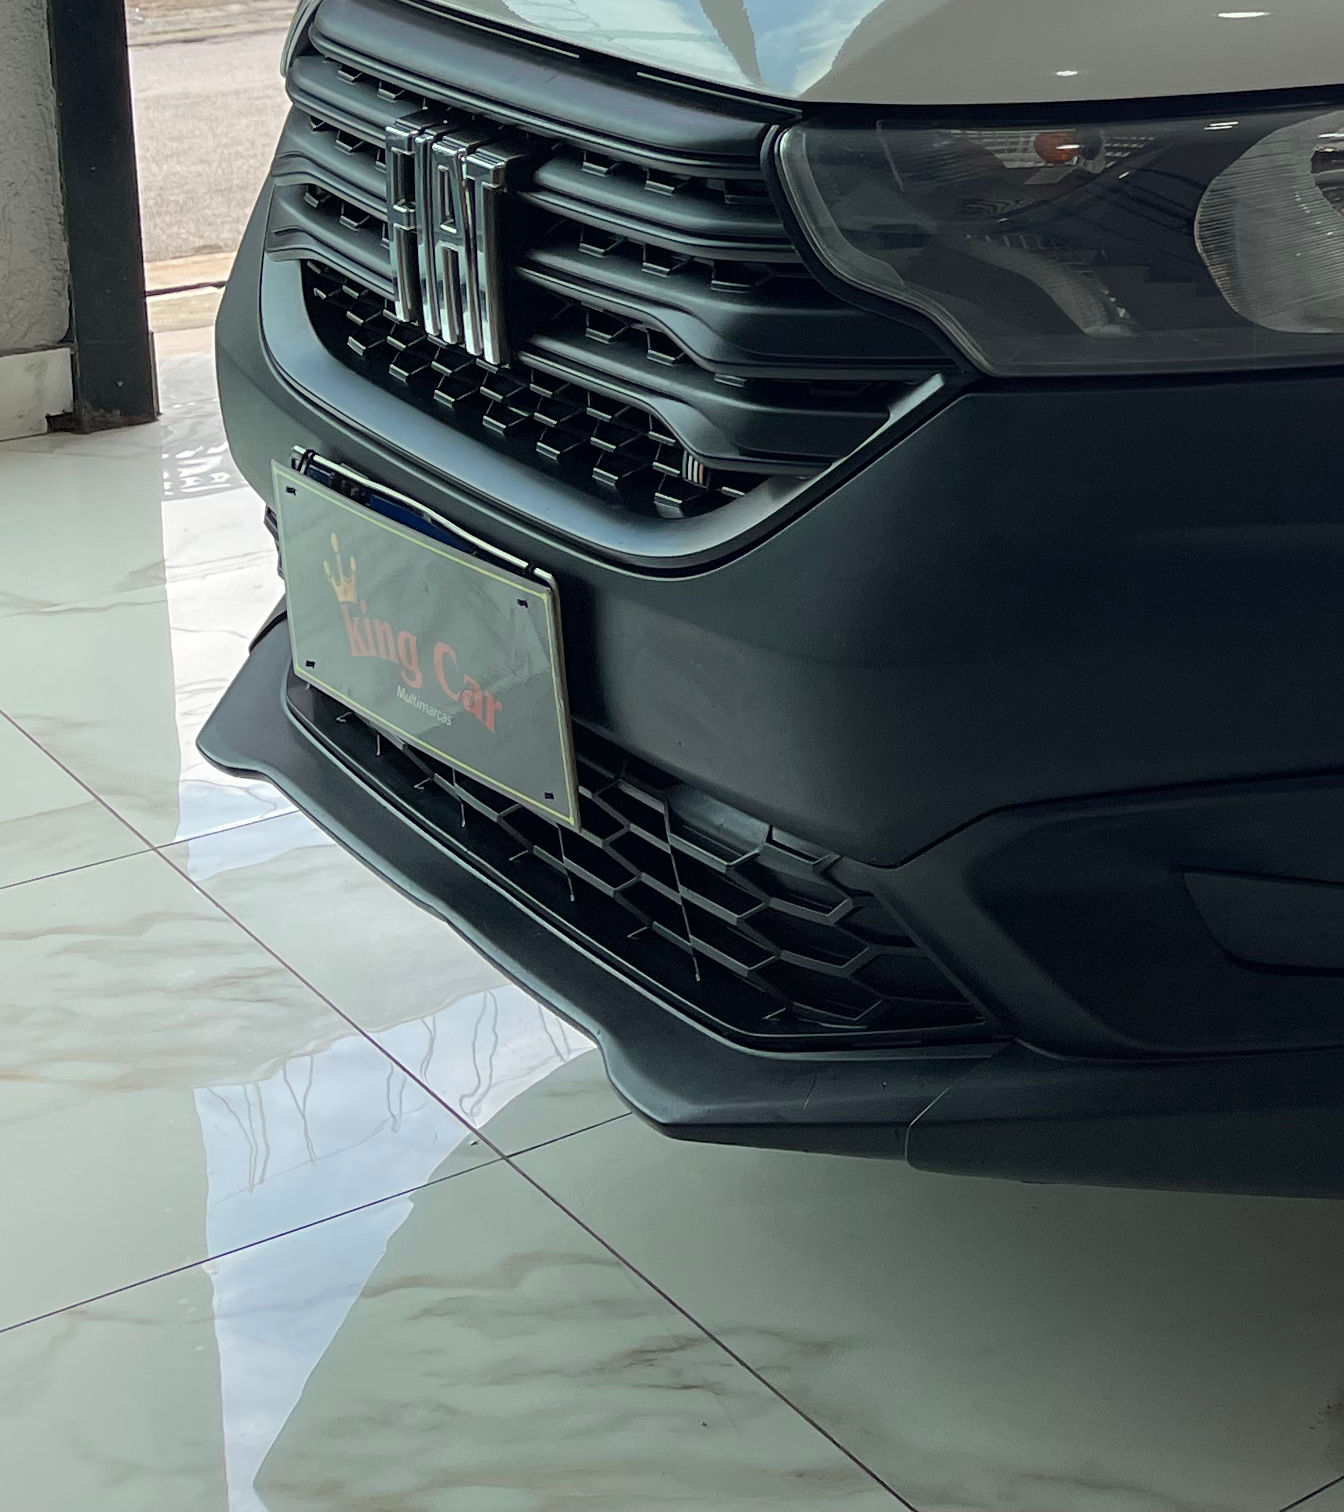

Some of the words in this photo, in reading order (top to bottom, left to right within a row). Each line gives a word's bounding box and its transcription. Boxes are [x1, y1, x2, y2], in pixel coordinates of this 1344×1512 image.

[385, 124, 508, 366] FIAT
[341, 600, 423, 689] king
[433, 641, 503, 734] Car
[397, 685, 453, 726] Multimarcas
